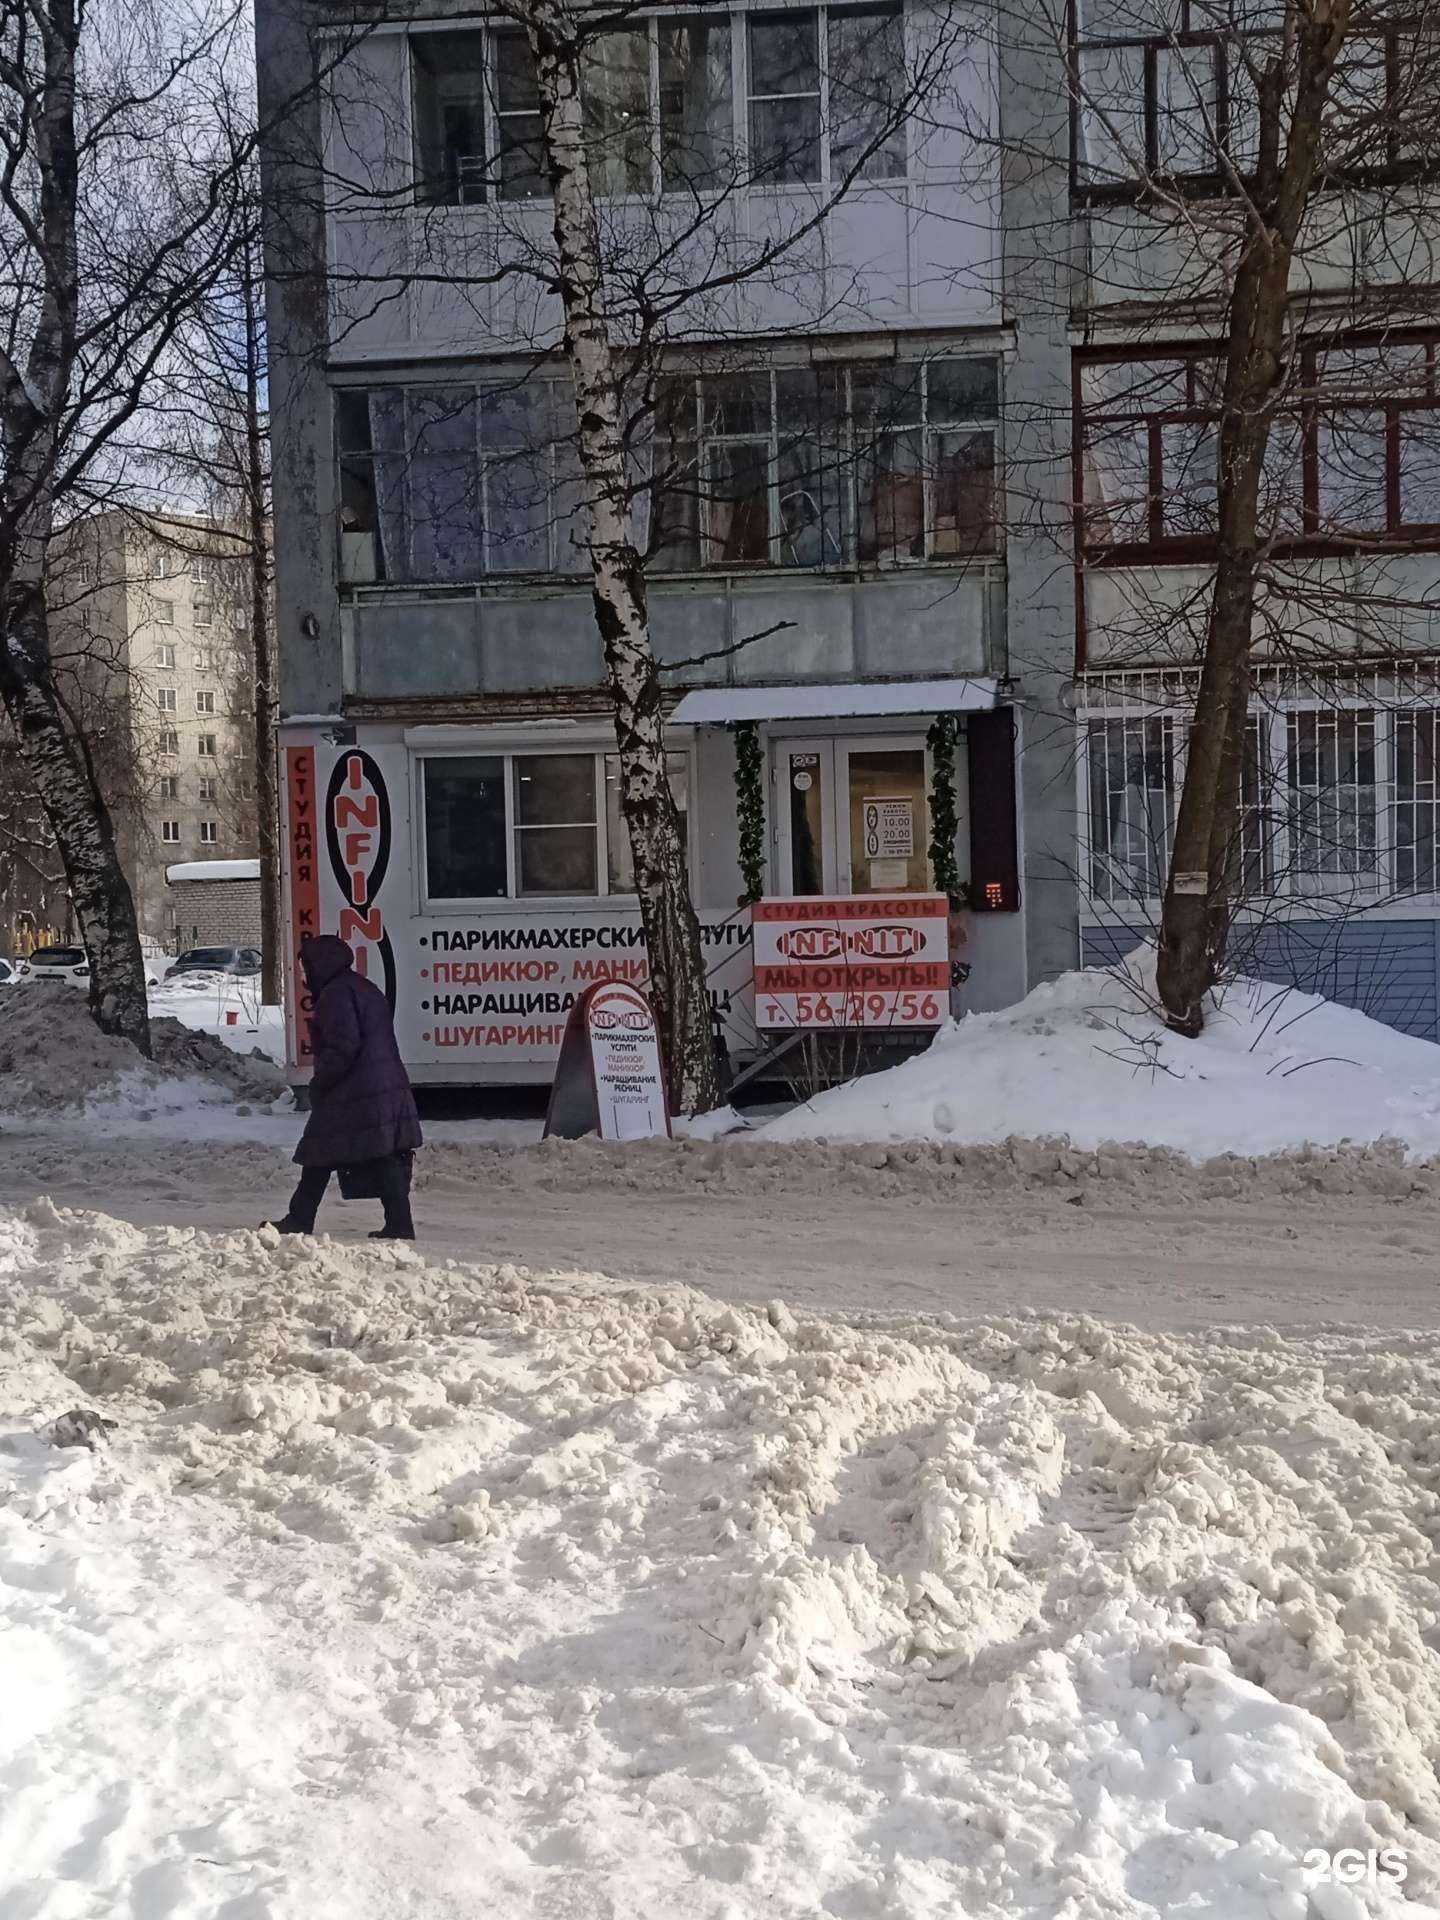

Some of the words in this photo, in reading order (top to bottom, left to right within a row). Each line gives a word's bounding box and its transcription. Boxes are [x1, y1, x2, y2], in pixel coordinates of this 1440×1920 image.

[294, 756, 312, 882] СТУДИЯ
[884, 817, 910, 826] 10.00
[884, 830, 910, 839] 20.00
[334, 756, 383, 976] INFINI
[763, 904, 837, 920] СТУДИЯ
[845, 901, 937, 917] КРАСОТЫ
[432, 927, 647, 951] ПАРИКМАХЕРСКИ
[782, 929, 920, 954] INFINITI
[432, 961, 566, 986] ПЕДИКЮР,
[572, 959, 648, 981] МАНИ
[764, 968, 807, 989] МЫ
[433, 992, 575, 1017] НАРАЩИВА
[796, 994, 939, 1022] 56-29-56
[434, 1025, 565, 1047] ШУГАРИНГ
[594, 1033, 655, 1043] ПАРИКМАХЕРСКИЕ
[610, 1043, 637, 1052] УСЛУГИ
[607, 1064, 645, 1073] МАНИКЮР
[603, 1075, 656, 1084] НАРАЩИВАНИЕ
[614, 1084, 642, 1093] РЕСНИЦ
[613, 1096, 649, 1104] ШУГАРИНГ
